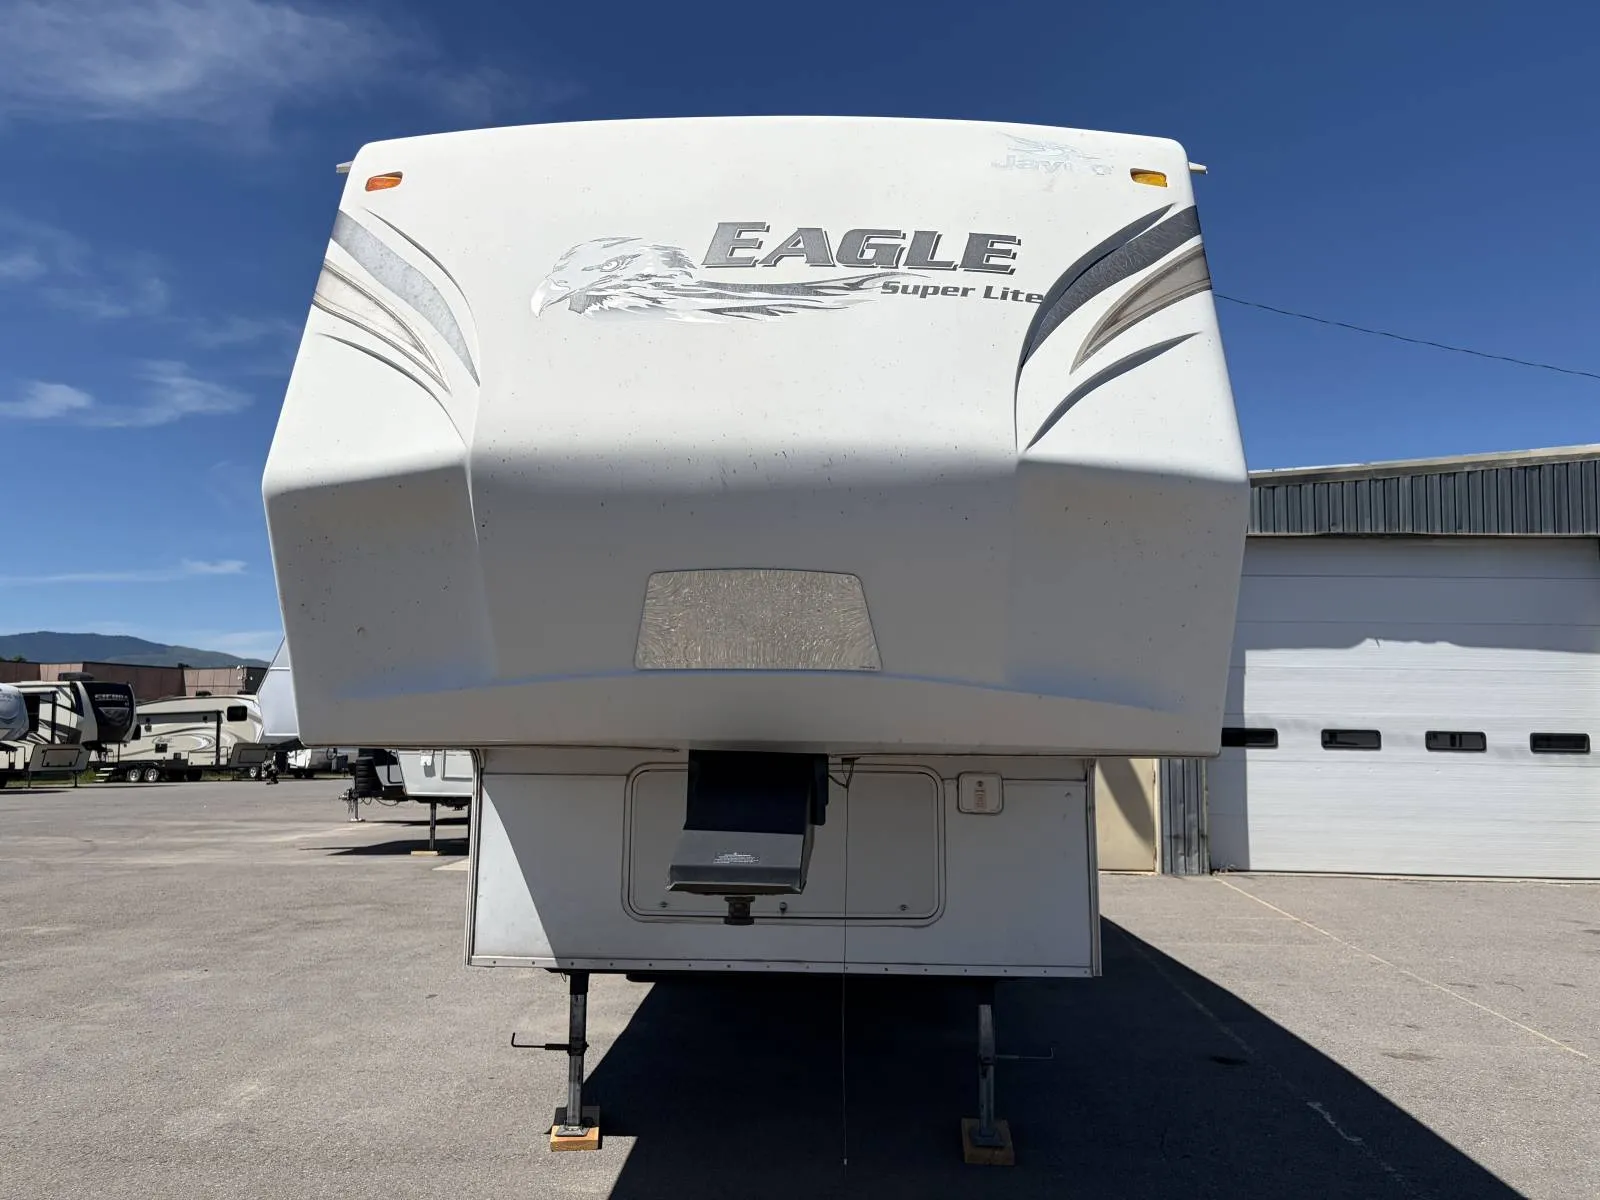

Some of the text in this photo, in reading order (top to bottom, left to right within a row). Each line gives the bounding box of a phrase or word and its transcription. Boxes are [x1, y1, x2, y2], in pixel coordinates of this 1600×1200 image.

[701, 221, 1022, 275] EAGLE
[881, 281, 1044, 304] Super Lite
